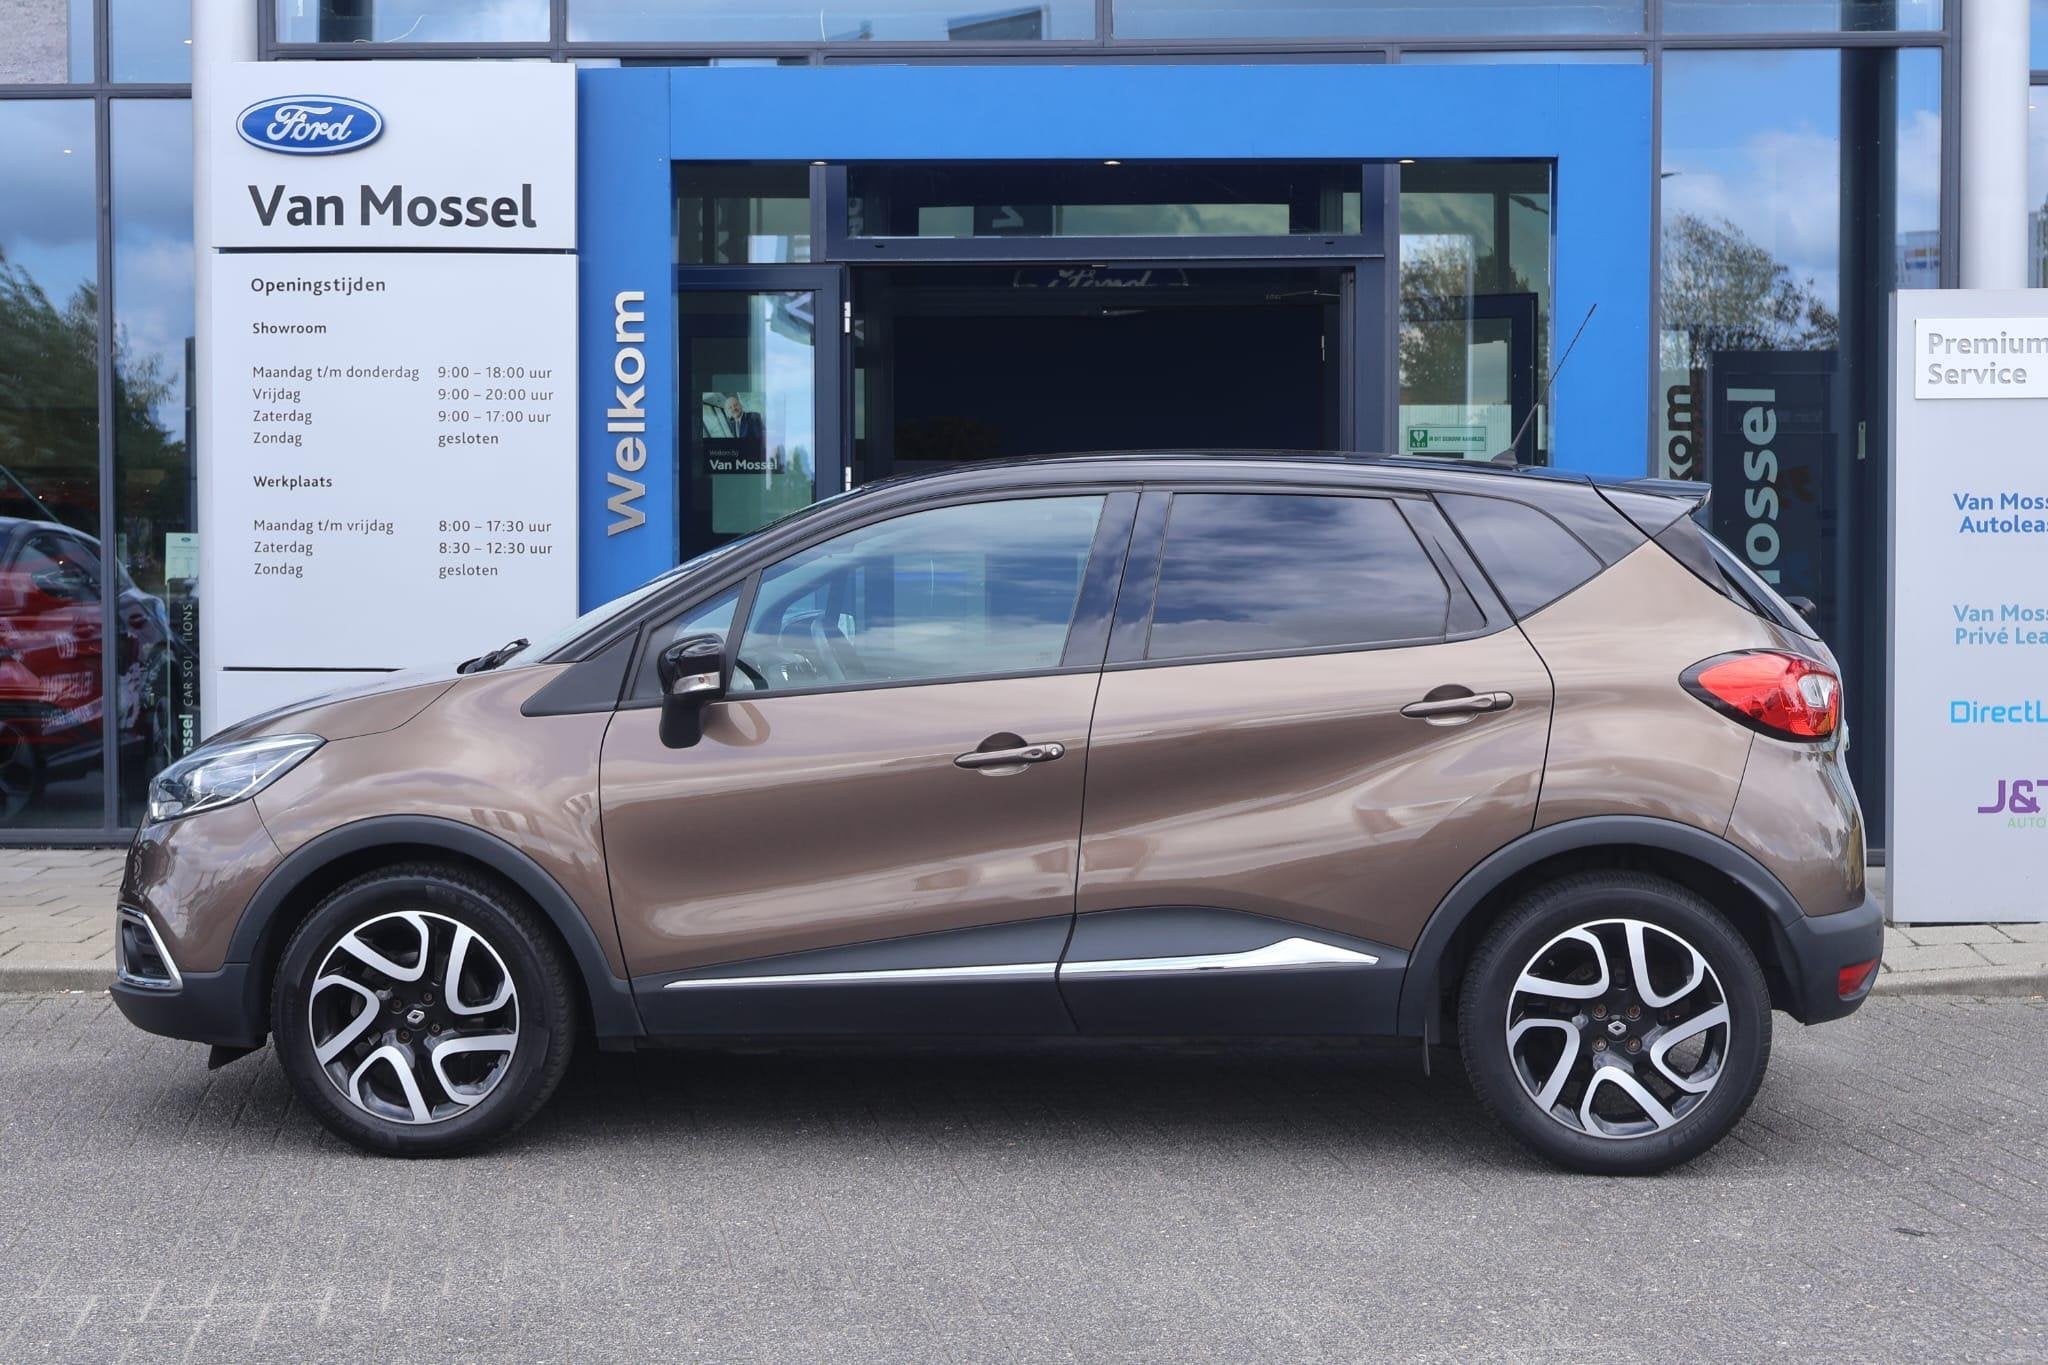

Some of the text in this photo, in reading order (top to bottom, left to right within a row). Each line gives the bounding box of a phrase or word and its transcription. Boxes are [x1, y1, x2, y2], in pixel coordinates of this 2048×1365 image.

[266, 105, 354, 141] Ford
[248, 184, 537, 228] Van Mossel
[251, 277, 385, 296] Openingstijden
[253, 322, 326, 334] Showroom
[1929, 331, 2048, 354] Premium
[253, 365, 312, 381] Maandag
[317, 366, 341, 378] t/m
[346, 365, 419, 381] donderdag
[438, 367, 469, 378] 9:00
[486, 367, 524, 378] 18:00
[530, 370, 552, 378] uur
[1928, 362, 2027, 384] Service
[253, 388, 301, 403] Vrijdag
[438, 389, 469, 400] 9:00
[486, 389, 525, 400] 20:00
[531, 392, 553, 400] uur
[253, 409, 312, 425] Zaterdag
[439, 411, 469, 422] 9:00
[486, 411, 523, 422] 17:00
[529, 414, 551, 422] uur
[607, 290, 646, 537] Welkom
[254, 432, 498, 447] Zondag gesloten
[709, 459, 778, 471] Van Mossel
[253, 475, 332, 491] Werkplaats
[1726, 387, 1781, 584] ossel
[1953, 493, 1993, 510] Van
[254, 519, 313, 534] Maandag
[318, 519, 342, 531] t/m
[347, 519, 393, 535] vrijdag
[439, 520, 470, 532] 8:00
[487, 521, 524, 532] 17:30
[529, 523, 551, 532] uur
[1960, 515, 2048, 533] Autolea
[254, 541, 313, 556] Zaterdag
[439, 542, 470, 553] 8:30
[487, 542, 525, 554] 12:30
[530, 546, 552, 554] uur
[254, 562, 497, 579] Zondag gesloten
[1953, 605, 2048, 622] Van Mos
[183, 604, 192, 680] SOTIONS
[1956, 627, 2008, 644] Privé
[183, 683, 192, 707] CAR
[1951, 700, 2048, 723] DirectL
